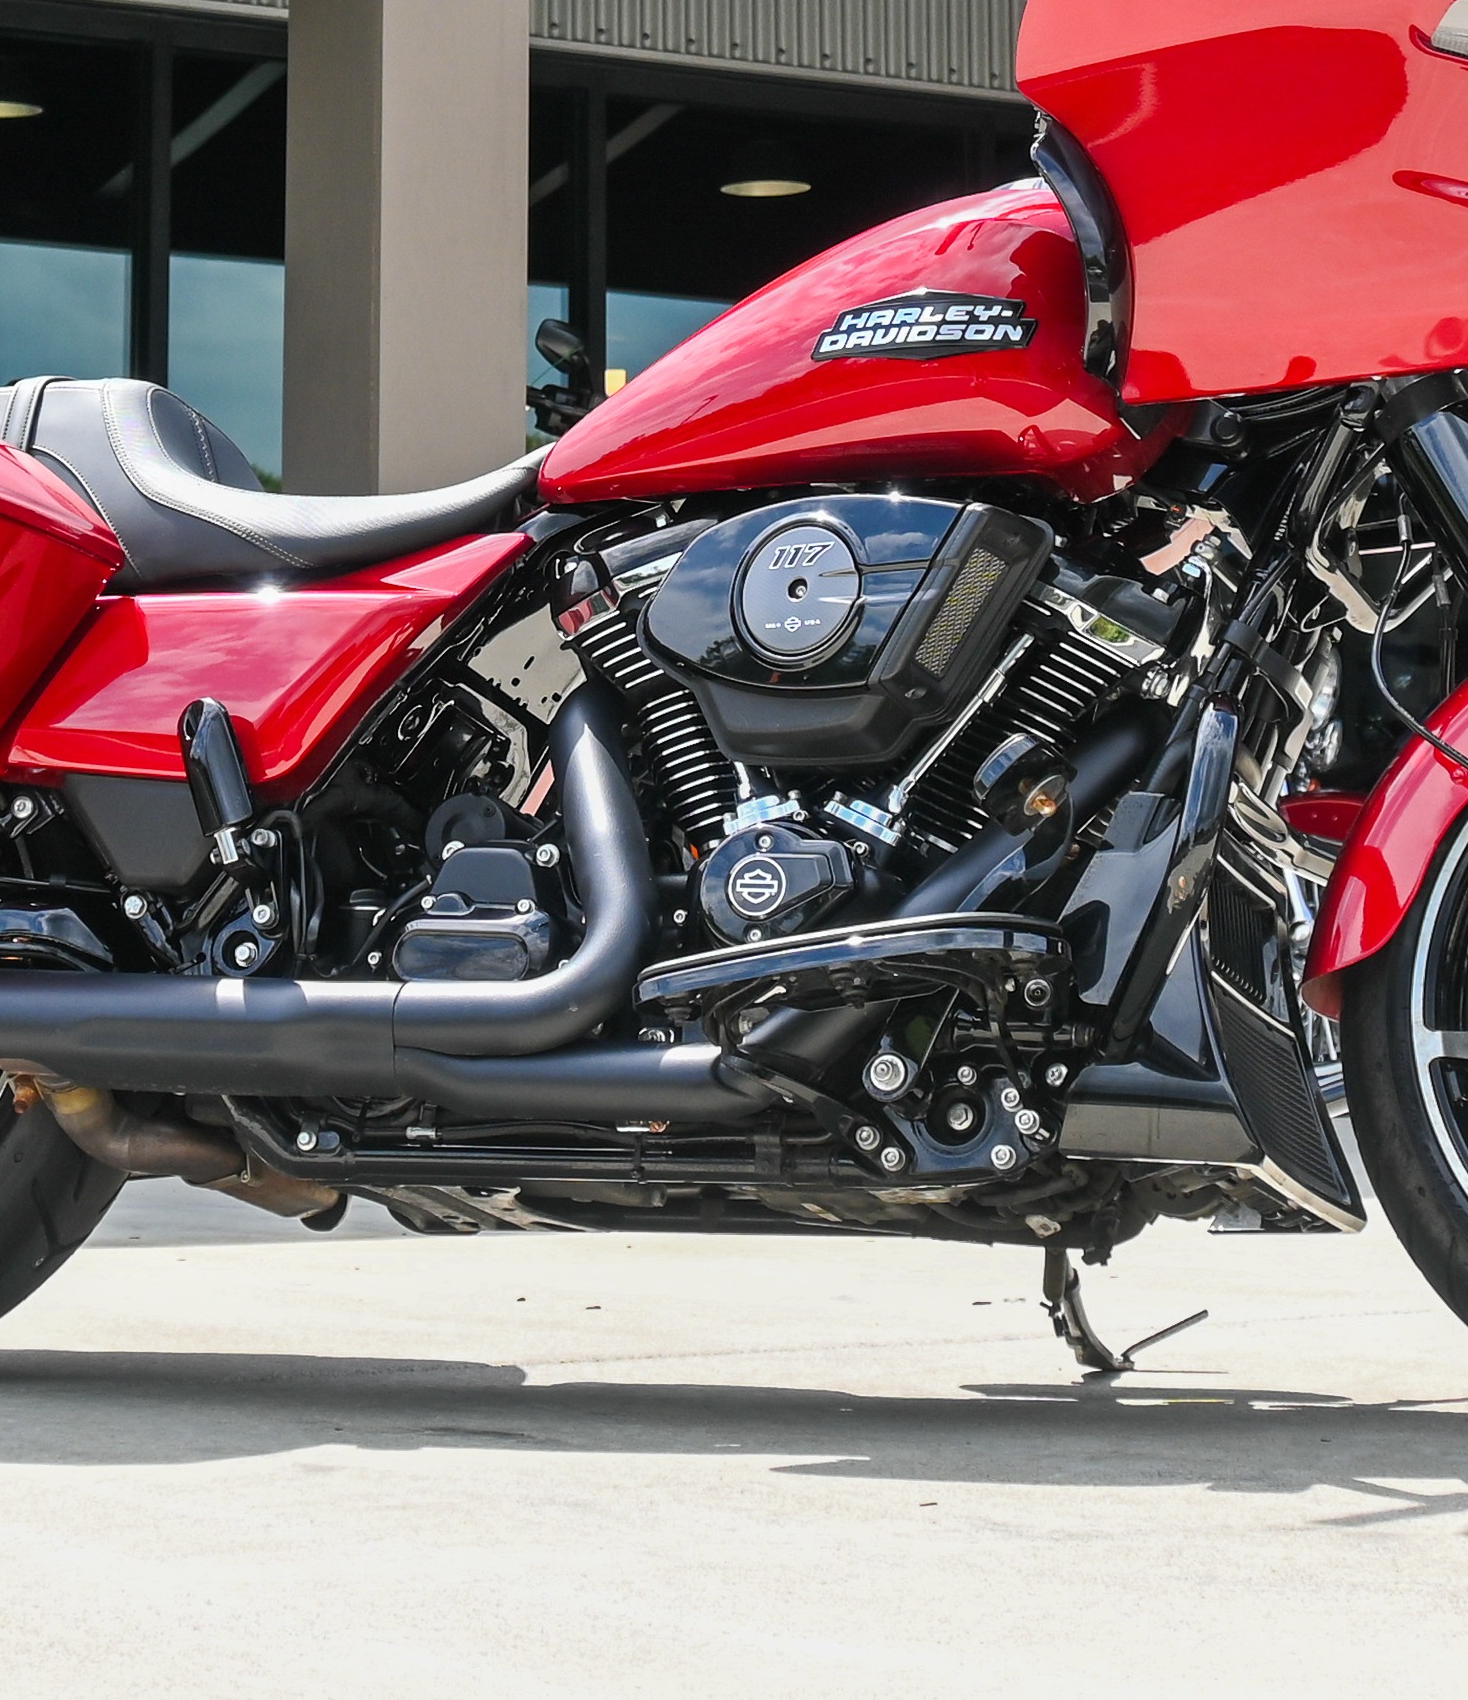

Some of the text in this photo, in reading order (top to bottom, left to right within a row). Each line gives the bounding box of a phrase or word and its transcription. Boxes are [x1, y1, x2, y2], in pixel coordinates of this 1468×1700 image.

[839, 304, 1014, 332] HARLEY-
[818, 323, 1024, 353] DAVIDSON
[768, 541, 835, 570] 117
